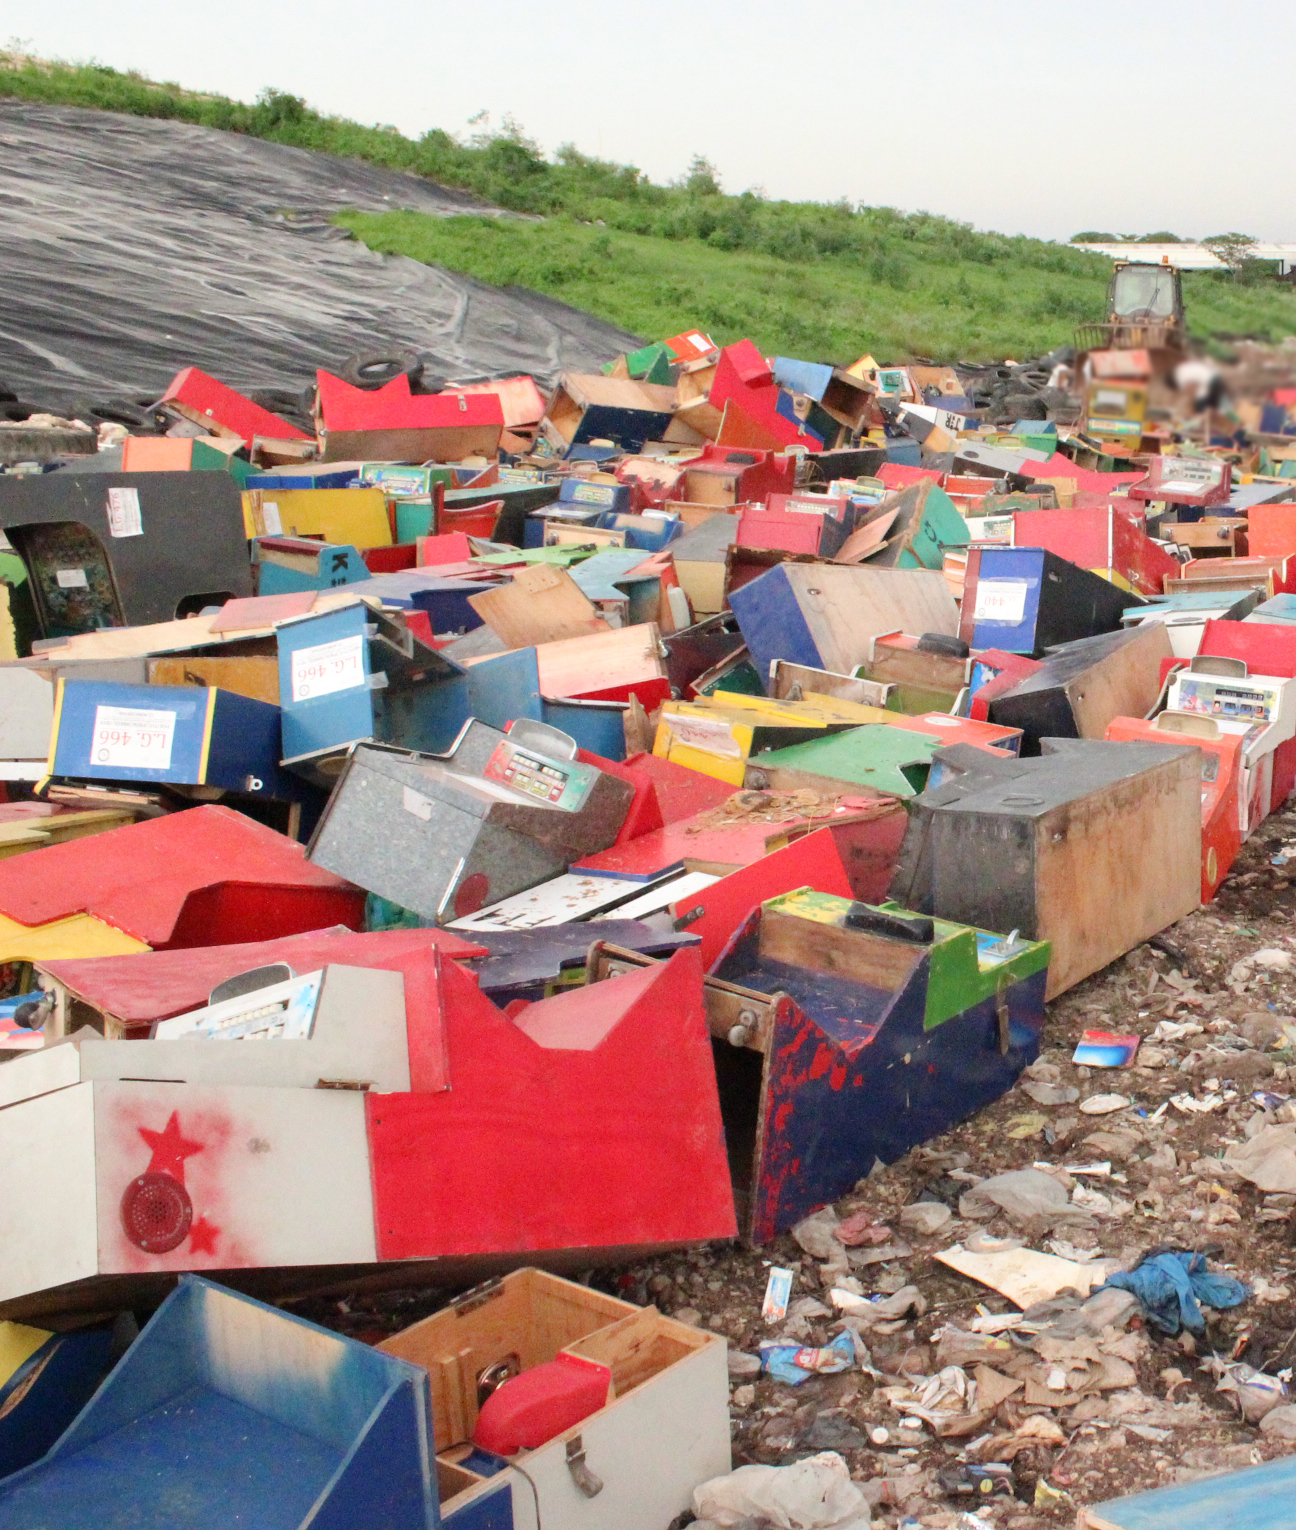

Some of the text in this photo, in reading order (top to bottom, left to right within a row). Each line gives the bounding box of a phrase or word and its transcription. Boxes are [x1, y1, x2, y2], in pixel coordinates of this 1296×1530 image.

[984, 596, 1005, 607] 440
[297, 664, 327, 683] 466
[330, 656, 357, 674] L.G.
[99, 730, 167, 749] L.G. 466
